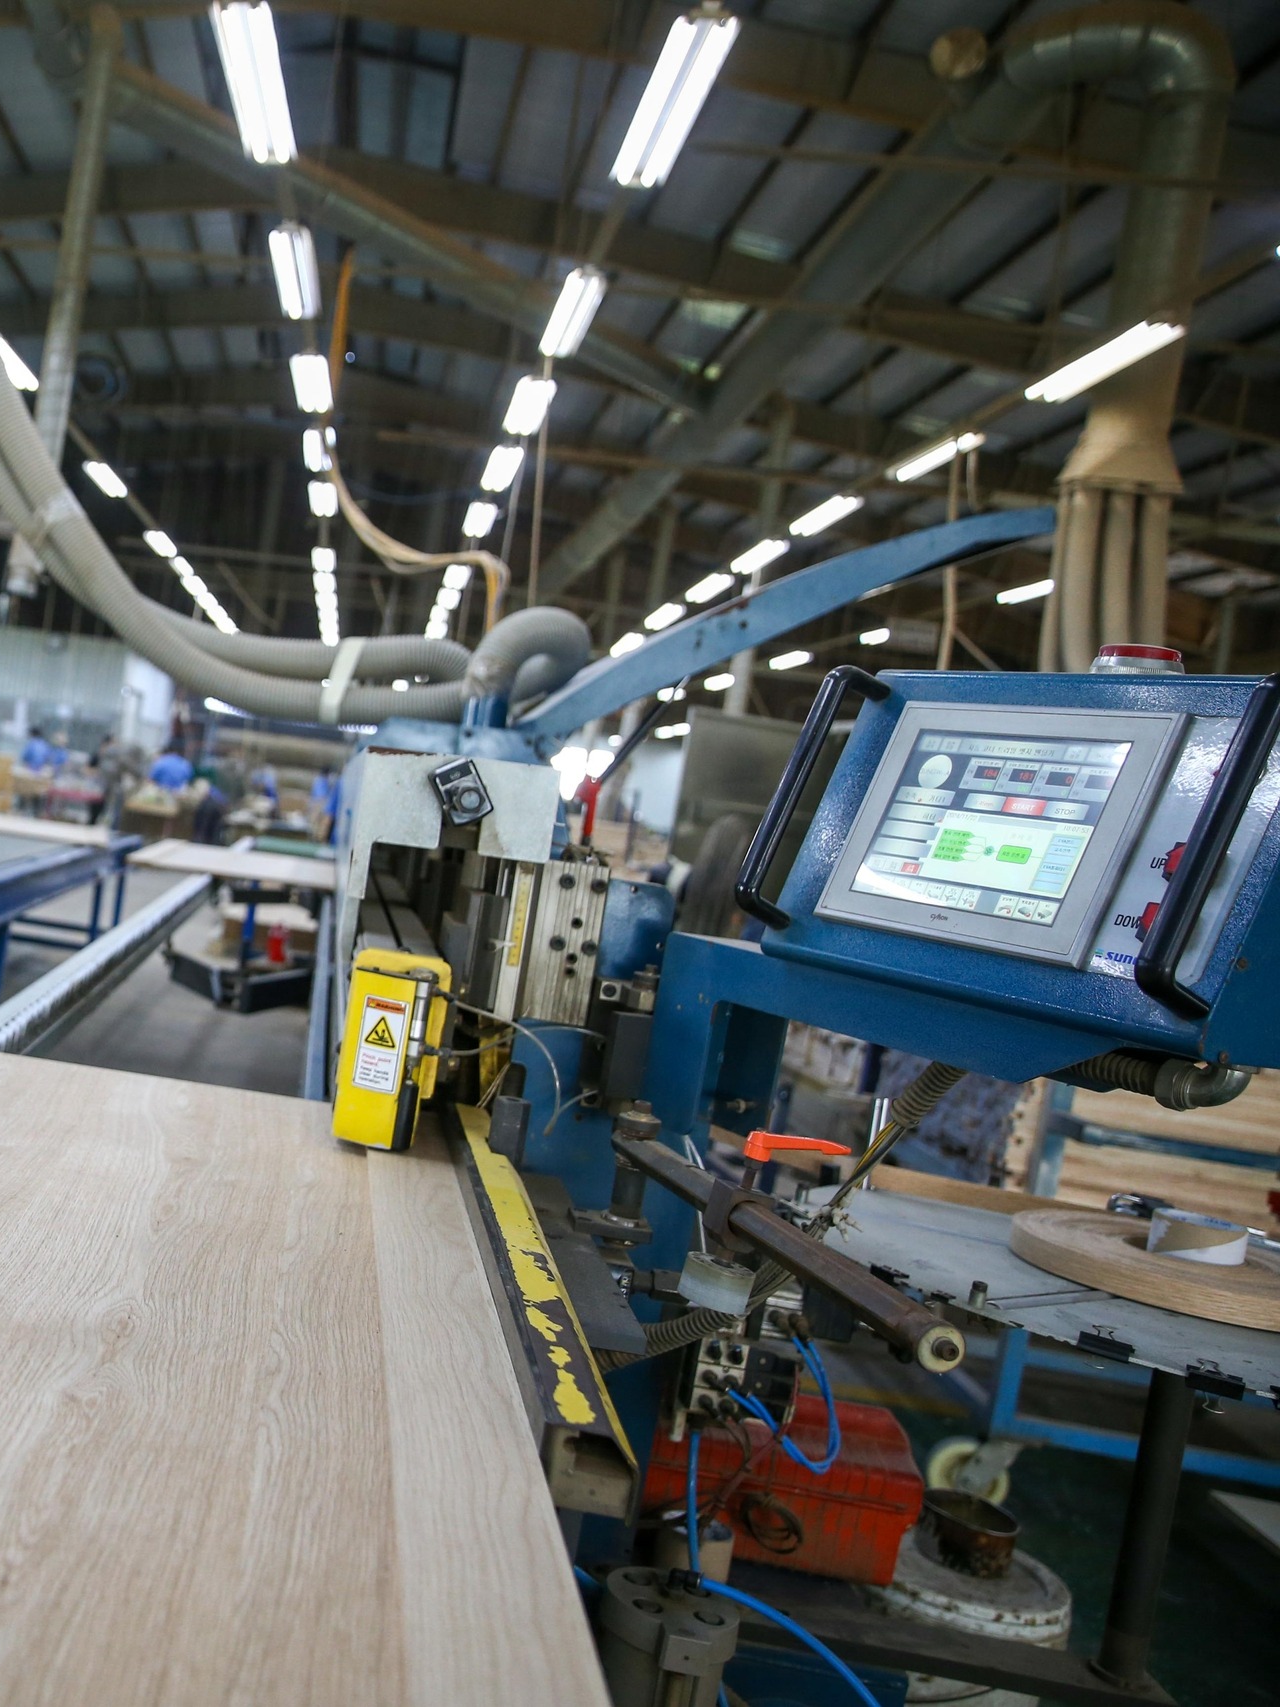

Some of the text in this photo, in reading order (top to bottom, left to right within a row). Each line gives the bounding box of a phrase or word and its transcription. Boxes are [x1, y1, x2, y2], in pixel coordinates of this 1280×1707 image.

[1011, 803, 1036, 812] START
[1054, 808, 1076, 816] STOP
[1150, 857, 1167, 869] UP
[1114, 914, 1141, 929] DOW
